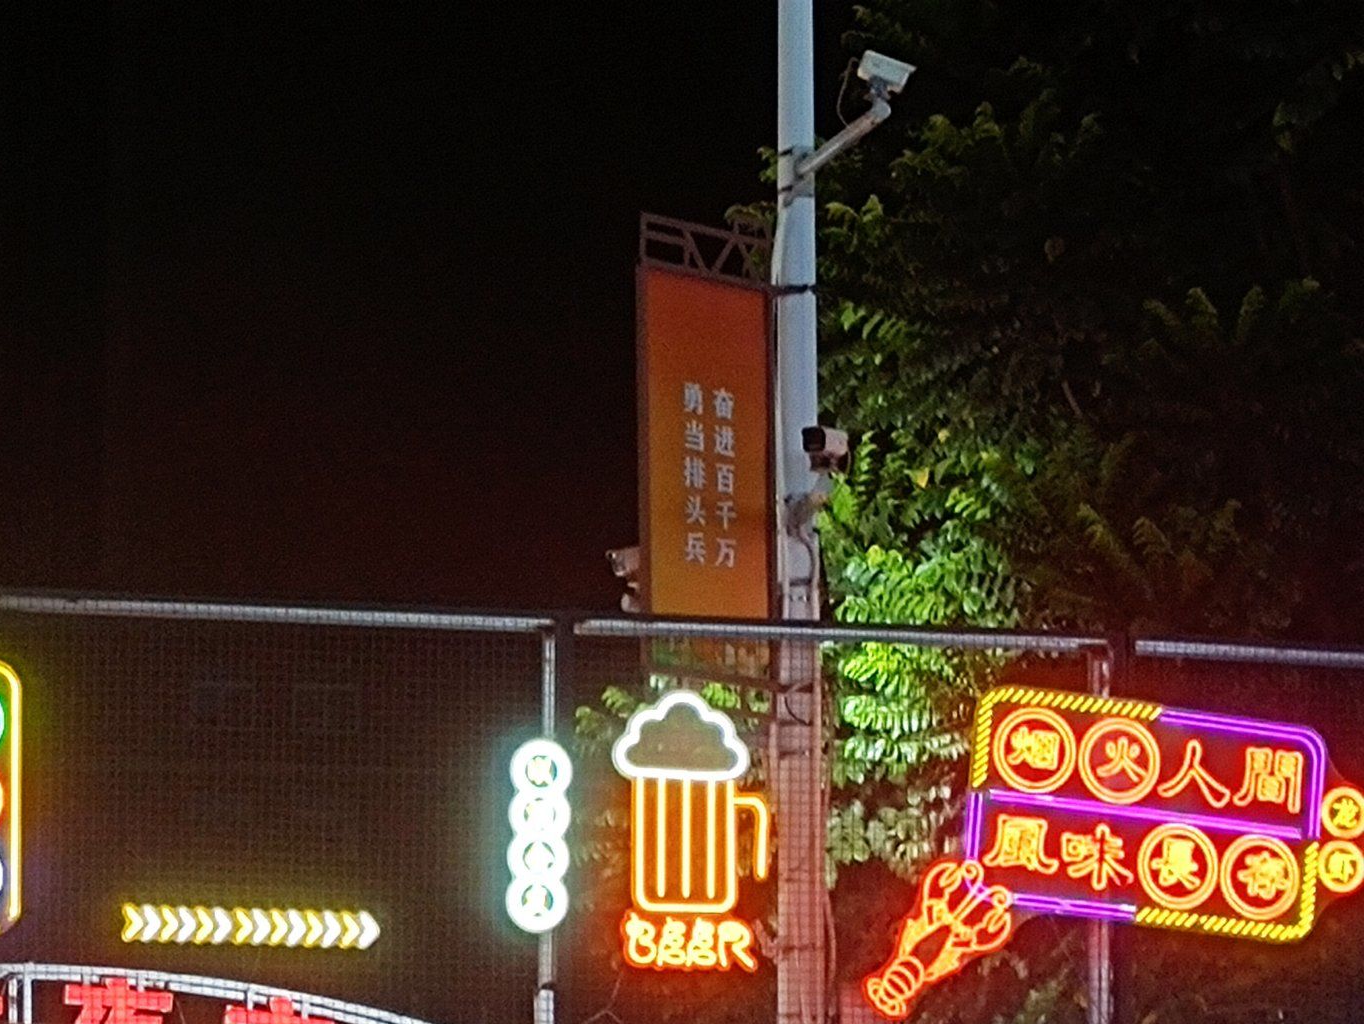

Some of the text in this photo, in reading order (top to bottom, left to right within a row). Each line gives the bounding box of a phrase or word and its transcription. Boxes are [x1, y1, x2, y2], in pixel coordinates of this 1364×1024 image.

[683, 382, 706, 566] 勇当排头兵
[713, 387, 736, 568] 奋进百千万
[623, 911, 757, 971] BEER
